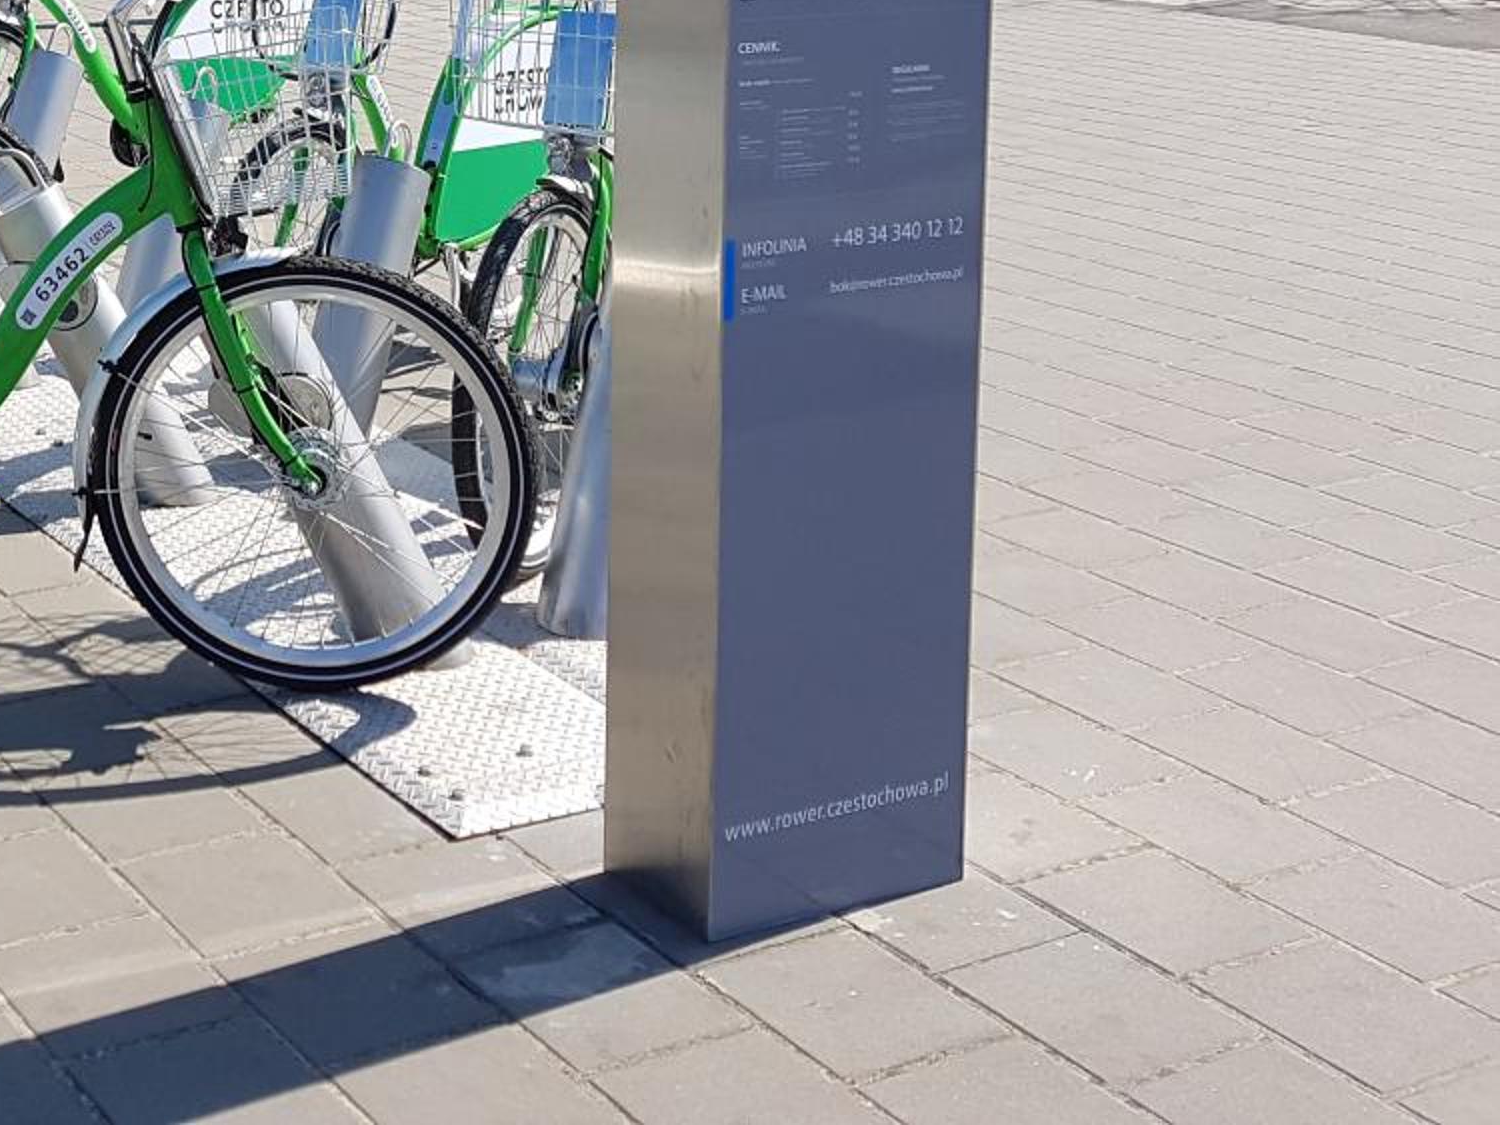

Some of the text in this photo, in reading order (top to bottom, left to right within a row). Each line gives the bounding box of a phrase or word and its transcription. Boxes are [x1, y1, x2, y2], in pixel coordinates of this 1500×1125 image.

[742, 216, 964, 258] INFOLINIA +48 34 340 12 12
[35, 247, 90, 302] 63462
[741, 284, 787, 304] E-MAIL
[724, 771, 950, 842] www.rower.czestochowa.pl
